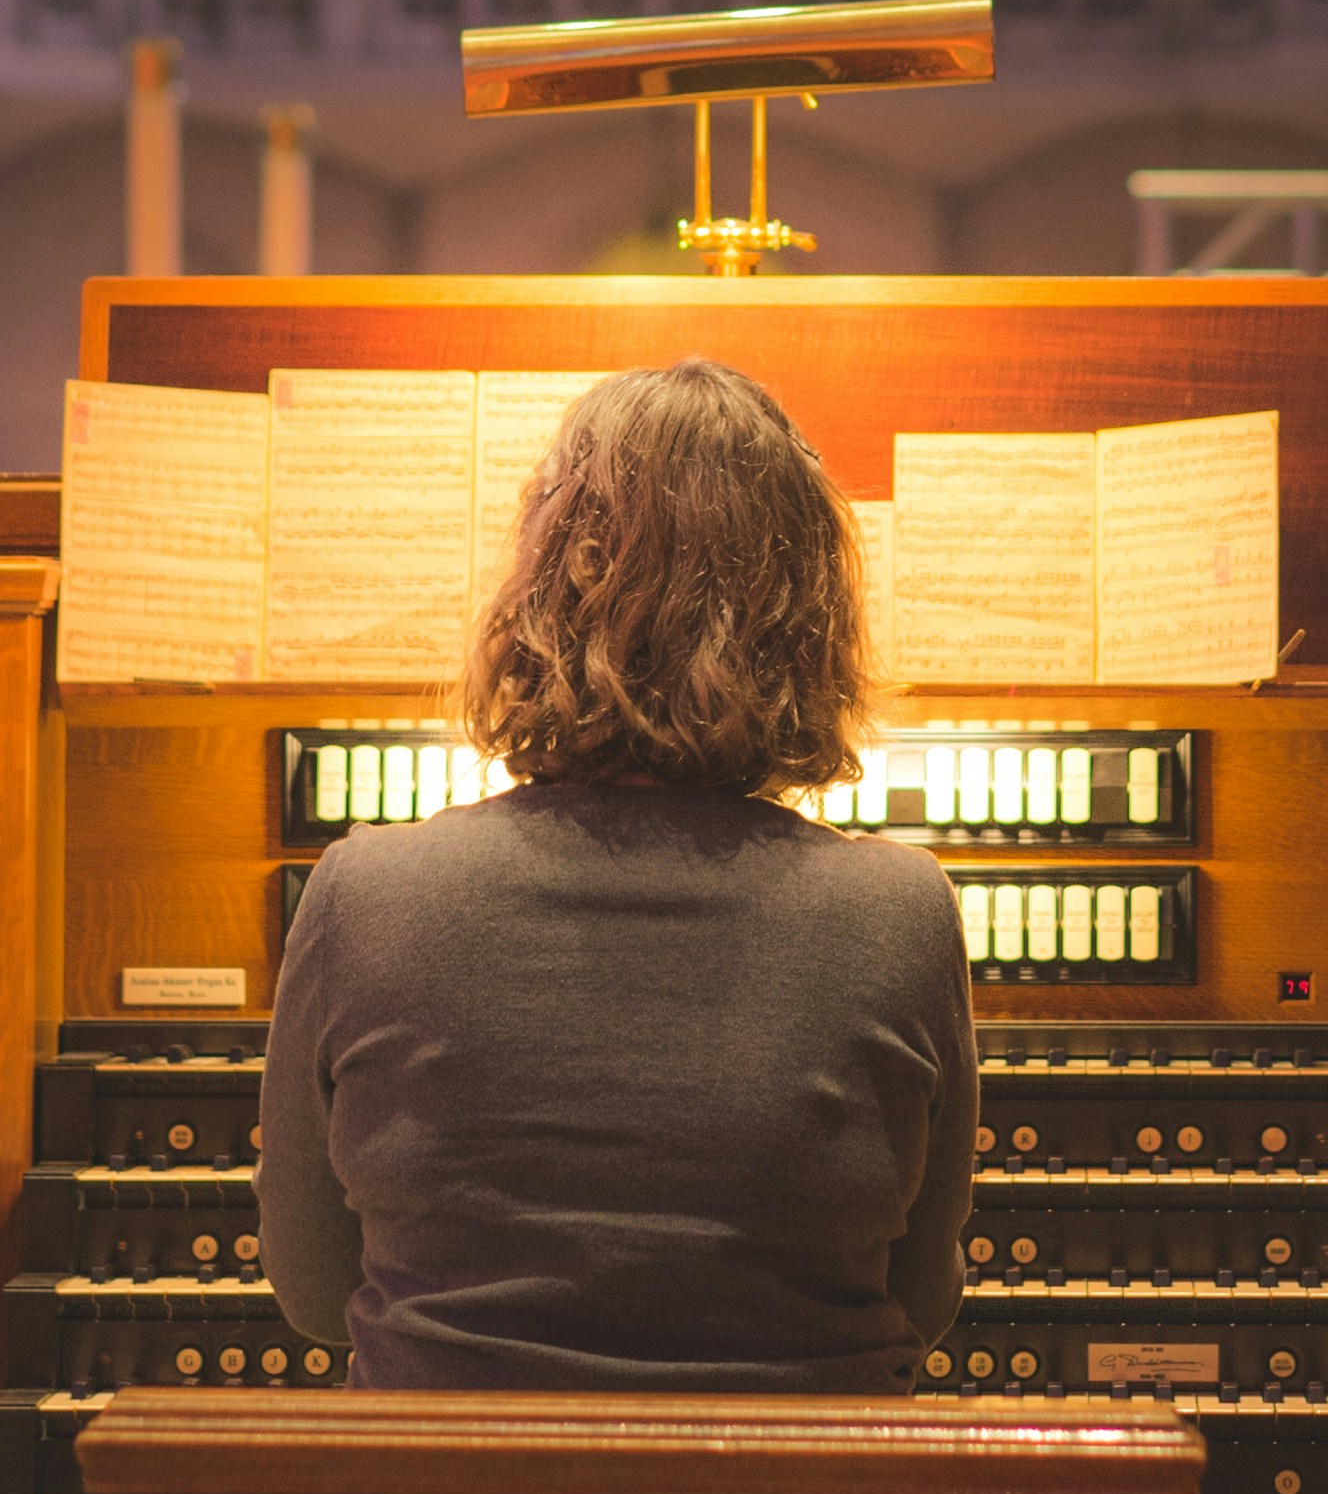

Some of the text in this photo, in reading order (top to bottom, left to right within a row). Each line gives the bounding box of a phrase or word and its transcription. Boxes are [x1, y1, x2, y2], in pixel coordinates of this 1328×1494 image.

[980, 1134, 987, 1144] P
[1021, 1134, 1030, 1144] R
[201, 1243, 209, 1253] A
[243, 1242, 250, 1252] B
[978, 1244, 986, 1255] T
[1019, 1245, 1029, 1256] U
[184, 1356, 194, 1366] G
[228, 1356, 237, 1366] H
[270, 1356, 278, 1367] J
[312, 1355, 322, 1366] K
